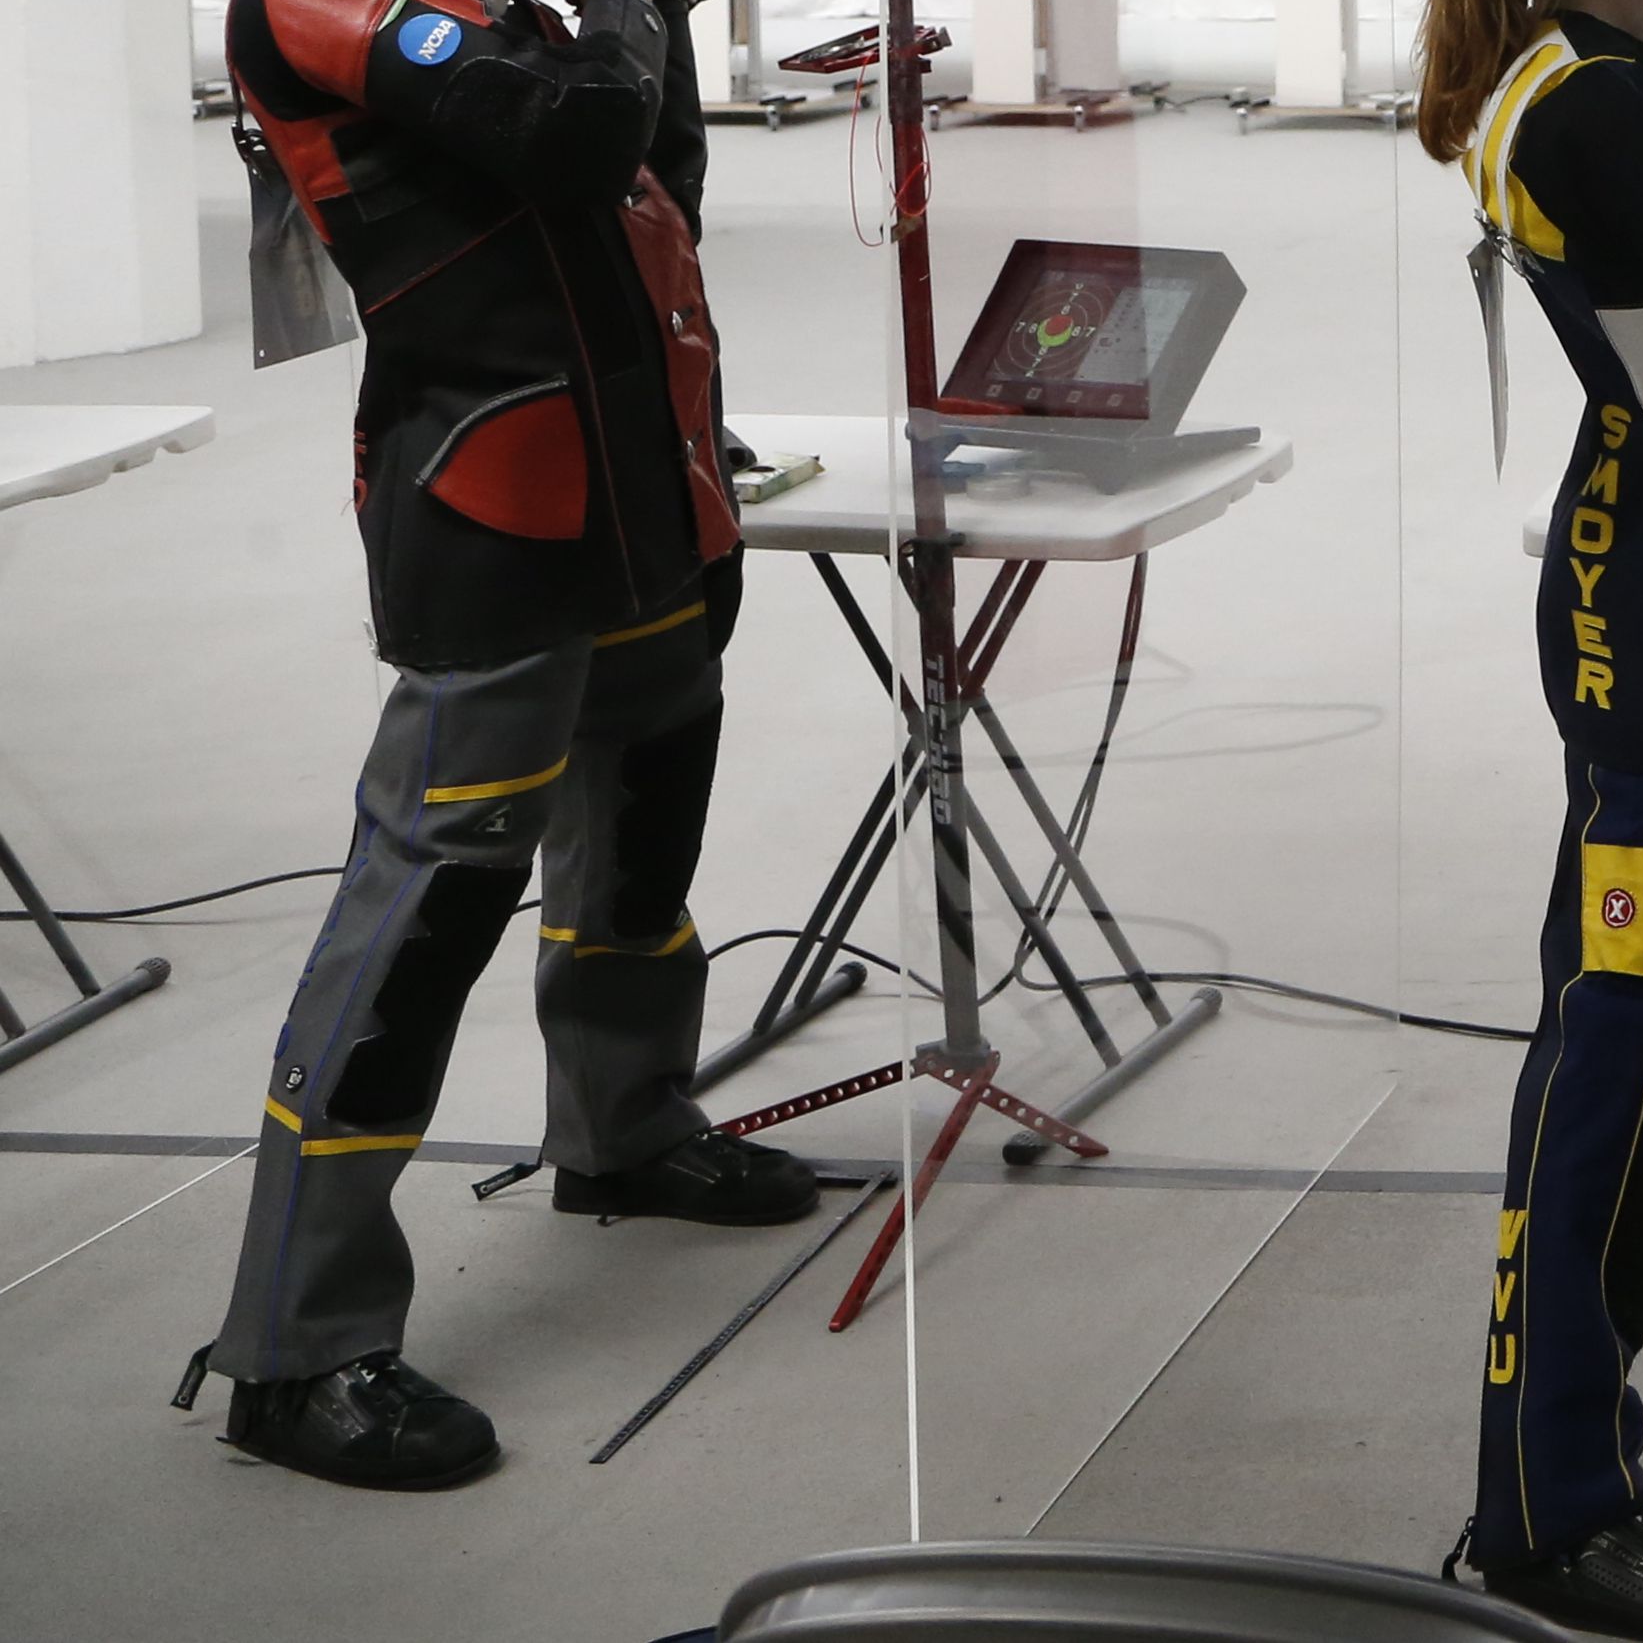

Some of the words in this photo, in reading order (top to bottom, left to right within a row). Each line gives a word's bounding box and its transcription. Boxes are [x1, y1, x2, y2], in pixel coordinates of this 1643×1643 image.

[417, 19, 457, 61] NCAA
[1569, 404, 1631, 711] SMOYER
[1609, 898, 1627, 920] X
[1490, 1209, 1528, 1385] WVU
